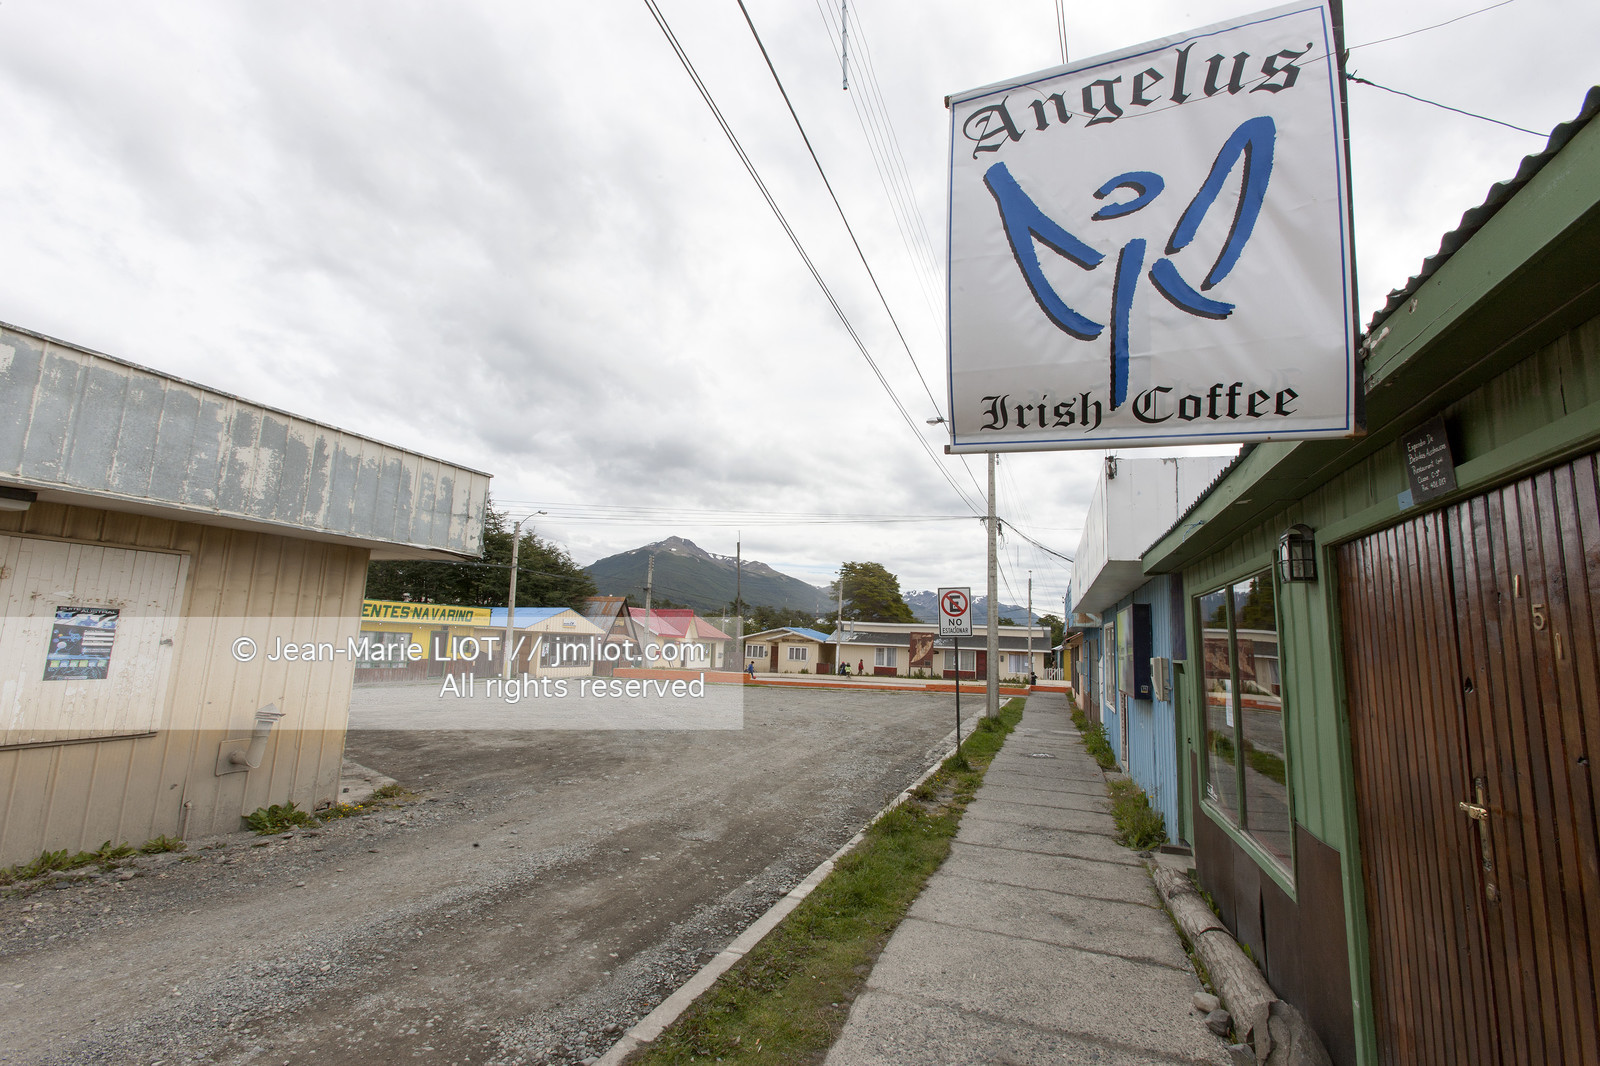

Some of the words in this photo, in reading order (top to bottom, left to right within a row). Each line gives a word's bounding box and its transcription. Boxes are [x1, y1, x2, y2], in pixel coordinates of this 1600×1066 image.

[962, 42, 1313, 160] Angelus
[980, 391, 1102, 434] Irish
[1132, 381, 1299, 424] Coffee
[412, 607, 474, 622] NAVARINO
[948, 618, 963, 626] NO
